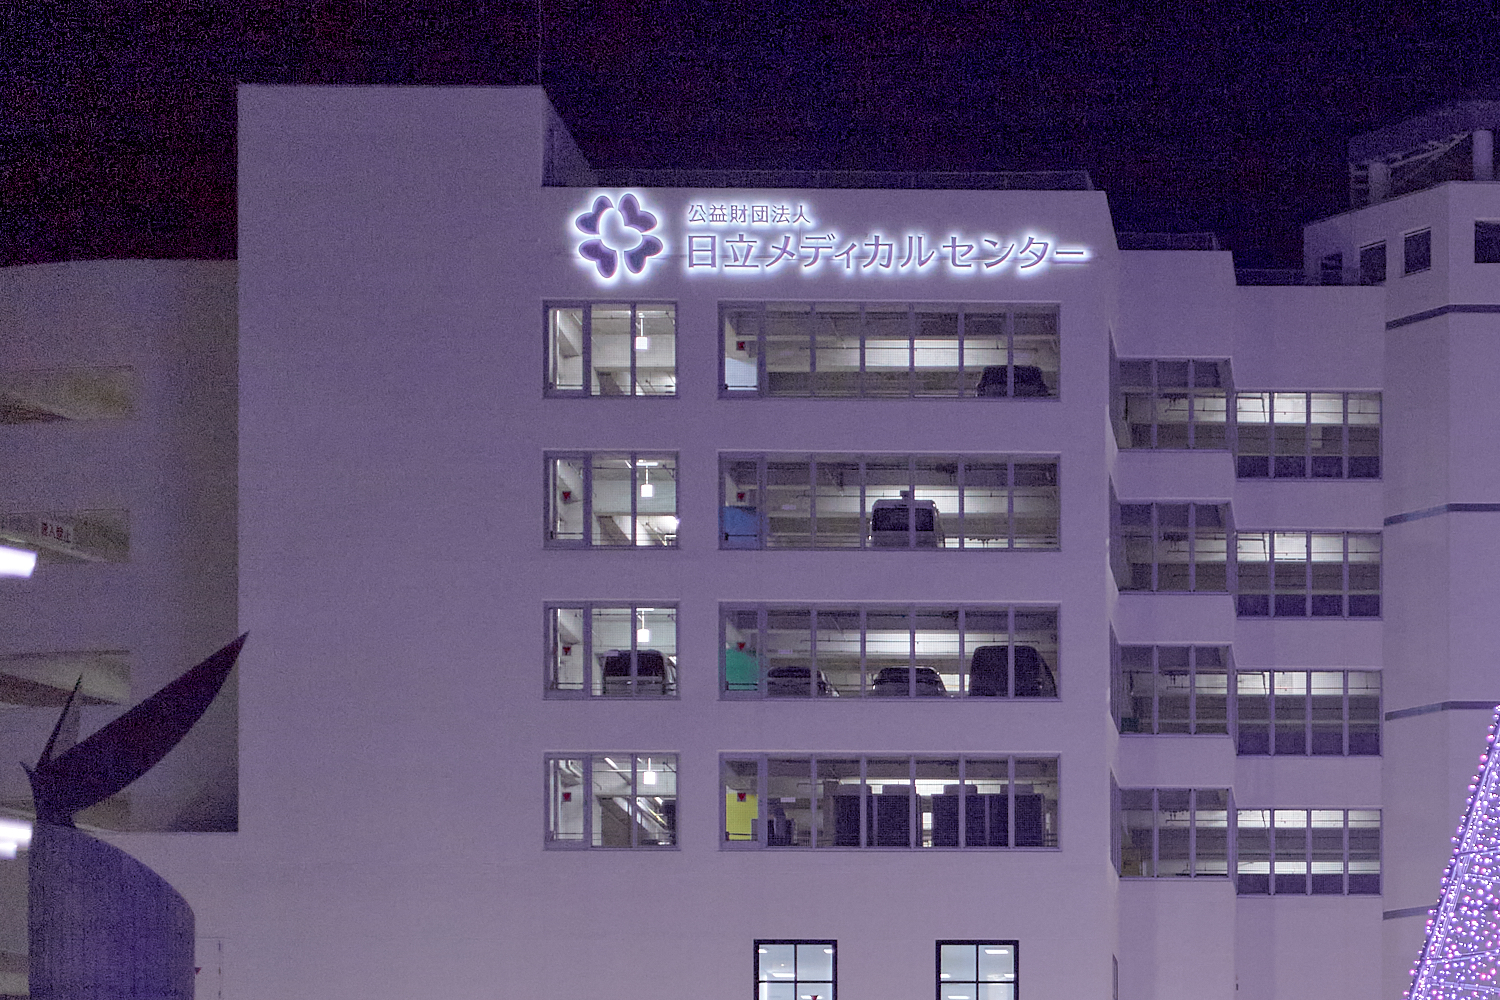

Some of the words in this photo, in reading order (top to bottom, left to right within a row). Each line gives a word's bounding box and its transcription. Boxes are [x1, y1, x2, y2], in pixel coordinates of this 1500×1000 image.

[688, 204, 811, 224] 公益財団法人
[687, 233, 1084, 270] 日立メディカルセンター
